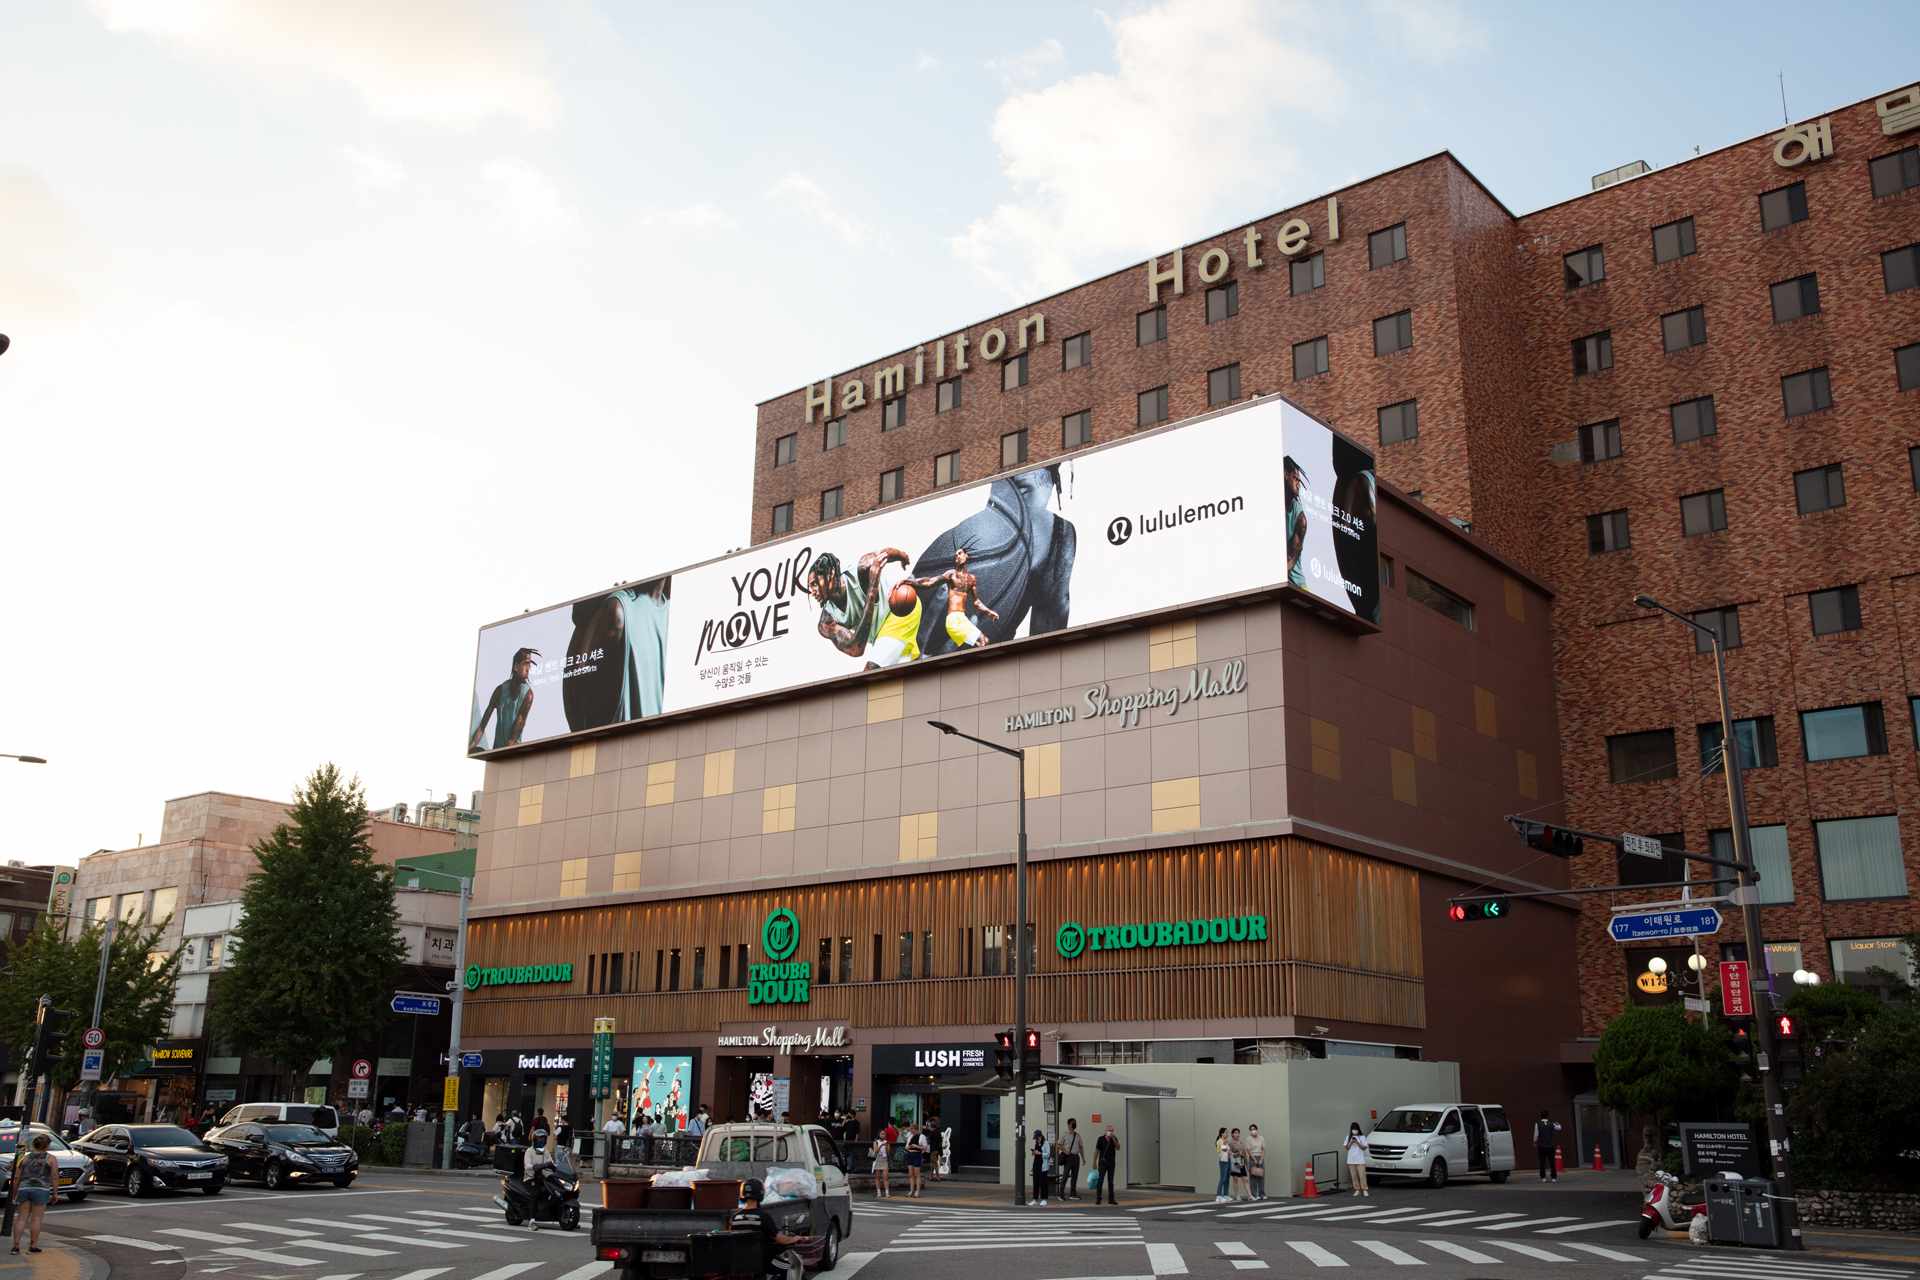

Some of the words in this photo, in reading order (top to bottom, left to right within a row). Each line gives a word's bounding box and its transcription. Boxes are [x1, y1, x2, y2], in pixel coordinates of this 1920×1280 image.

[805, 312, 1045, 424] Hamilton
[1149, 197, 1339, 303] Hotel
[1140, 496, 1243, 535] lululemon
[731, 547, 812, 606] YOUR
[576, 653, 588, 664] 2.0
[589, 648, 604, 661] 셔츠
[700, 666, 720, 680] 당신이
[746, 659, 752, 669] 수
[755, 656, 768, 668] 있는
[1005, 706, 1074, 732] HAMILTON
[1082, 684, 1181, 728] Shopping
[1181, 660, 1248, 703] Mall
[1087, 915, 1267, 951] TROUBADOUR
[1614, 924, 1629, 933] 177
[1644, 914, 1682, 926] 이태원로
[1700, 916, 1715, 925] 181
[431, 938, 455, 952] 치과
[481, 964, 573, 987] TROUBADOUR
[749, 961, 811, 981] TROUBA
[748, 980, 811, 1004] DOUR
[87, 1033, 100, 1044] 50
[718, 1035, 759, 1046] HAMILTON
[761, 1026, 811, 1055] Shopping
[811, 1026, 845, 1047] Mall
[518, 1054, 540, 1069] Foot
[541, 1054, 576, 1069] Locker
[915, 1050, 961, 1067] LUSH
